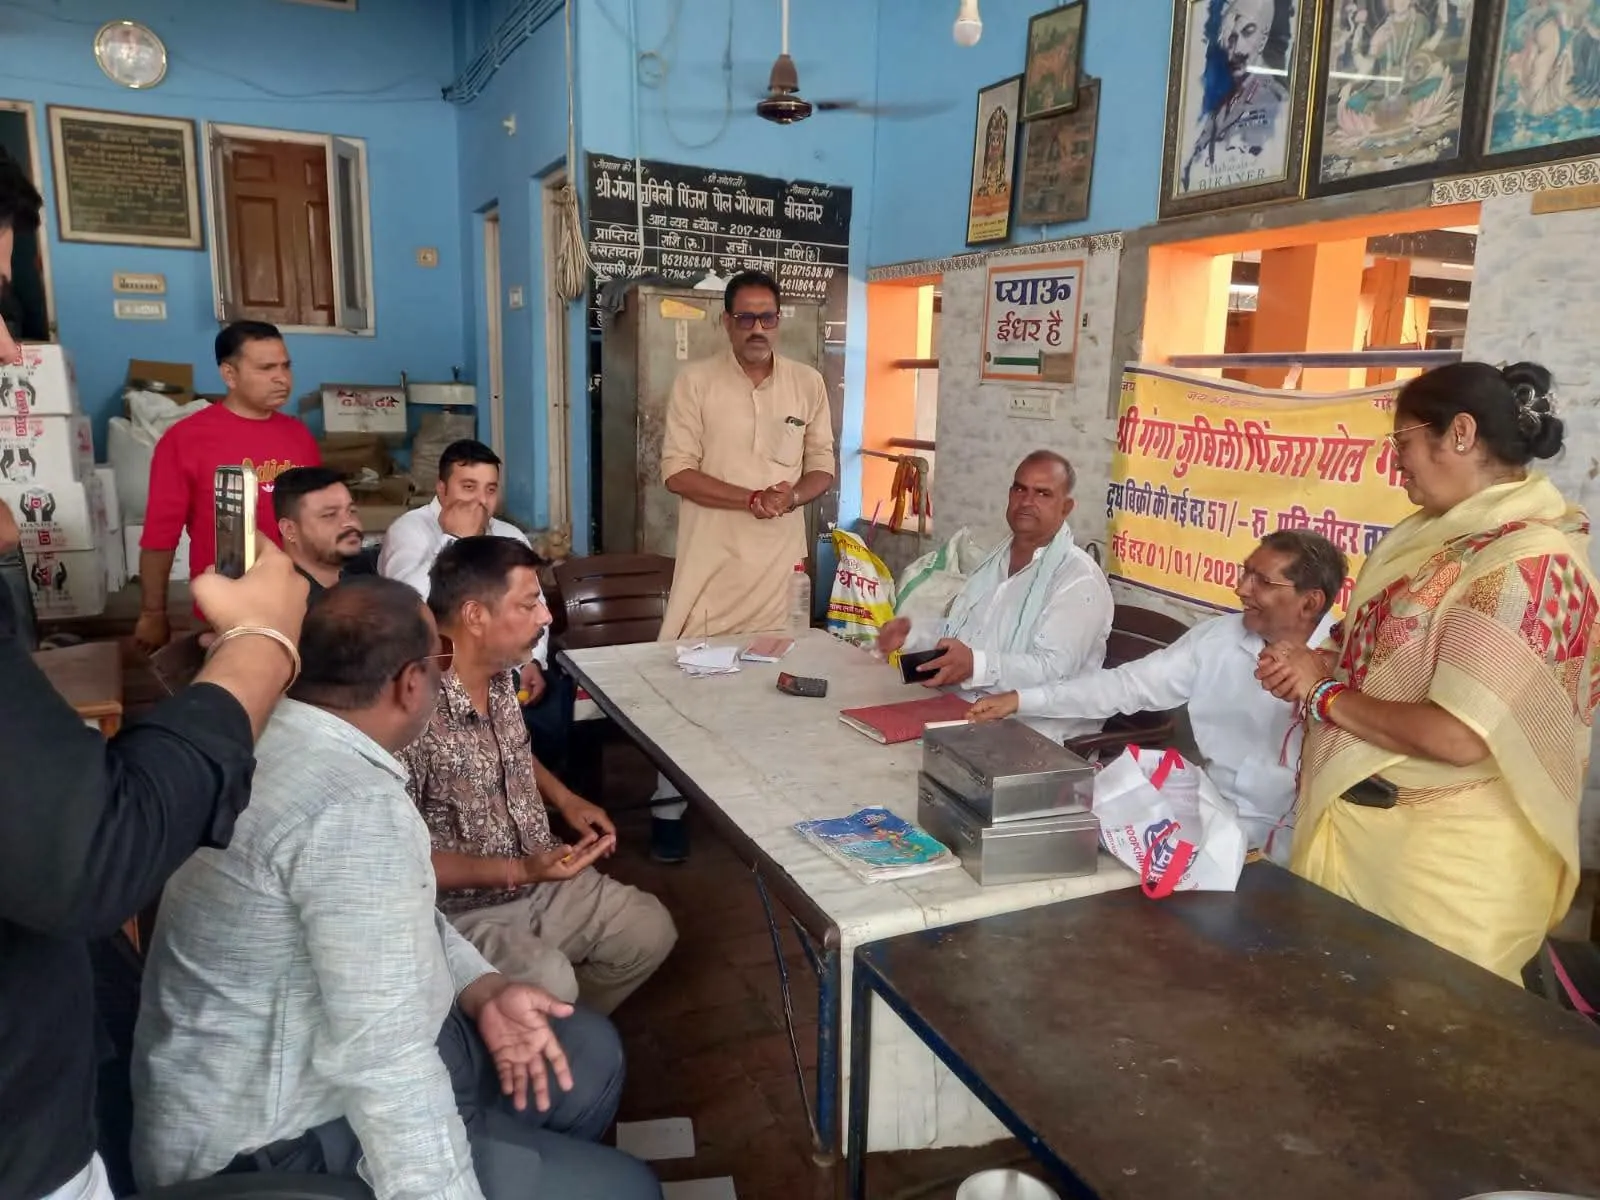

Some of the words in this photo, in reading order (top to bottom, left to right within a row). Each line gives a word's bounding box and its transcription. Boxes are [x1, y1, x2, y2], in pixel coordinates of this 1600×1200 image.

[595, 171, 611, 198] श्री
[611, 176, 636, 201] गंगा
[676, 181, 708, 211] पिंजरा
[712, 187, 732, 214] पोल
[783, 195, 824, 225] बीकानेर
[647, 214, 667, 228] आय
[729, 223, 782, 239] 2017-2018
[660, 231, 681, 248] राशि
[783, 243, 805, 260] राशि
[994, 275, 1075, 306] प्याऊ
[996, 310, 1042, 342] ईधर
[1045, 309, 1063, 347] है
[1173, 415, 1243, 479] जुबिली
[1243, 420, 1318, 478] पिंजरा
[1317, 423, 1377, 483] पोल
[1106, 482, 1124, 519] दूध
[1152, 484, 1169, 520] की
[1170, 487, 1190, 528] नई
[1189, 498, 1206, 528] दर
[1112, 530, 1129, 563] नई
[1128, 539, 1146, 564] दर
[1145, 543, 1246, 588] 01/01/202
